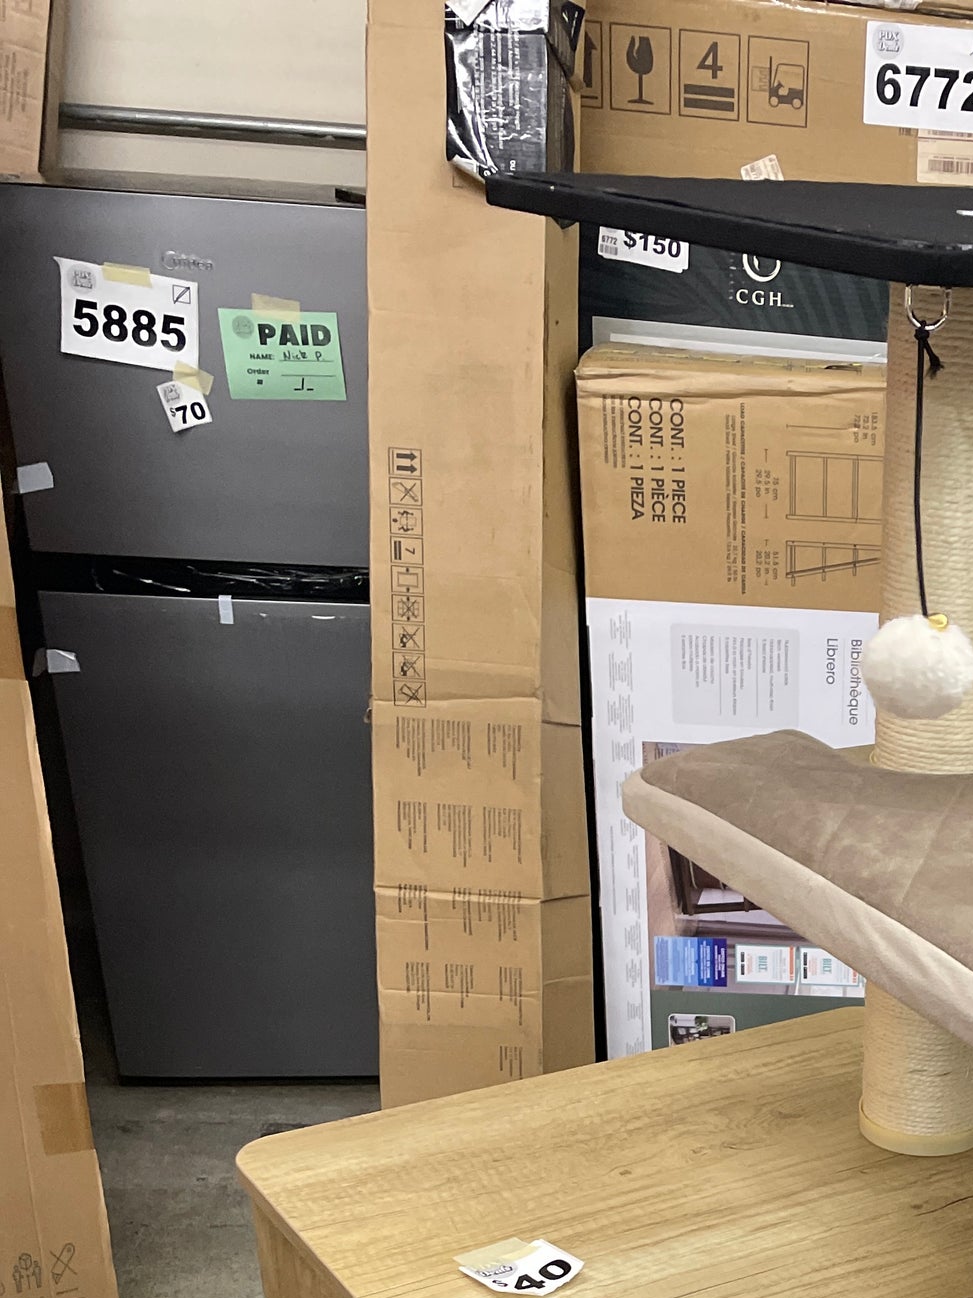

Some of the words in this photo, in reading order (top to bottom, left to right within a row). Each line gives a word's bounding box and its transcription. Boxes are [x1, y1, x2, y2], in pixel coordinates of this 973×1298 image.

[696, 41, 725, 79] 4
[601, 234, 618, 246] 6772
[623, 230, 682, 258] $150
[735, 289, 782, 307] CGH
[73, 298, 187, 353] 5885
[257, 323, 332, 346] PAID
[170, 401, 206, 424] $70
[628, 395, 643, 449] CONT.
[649, 396, 664, 450] CONT.
[670, 398, 685, 451] CONT.
[870, 433, 877, 446] cm
[630, 476, 645, 520] PIEZA
[651, 478, 669, 523] PIÈCE
[672, 479, 687, 524] PIECE
[754, 486, 761, 498] po
[764, 487, 770, 495] in
[772, 488, 779, 501] cm
[754, 567, 761, 578] po
[772, 568, 779, 580] cm
[825, 638, 838, 685] Librero
[848, 638, 863, 726] Bibliothèque
